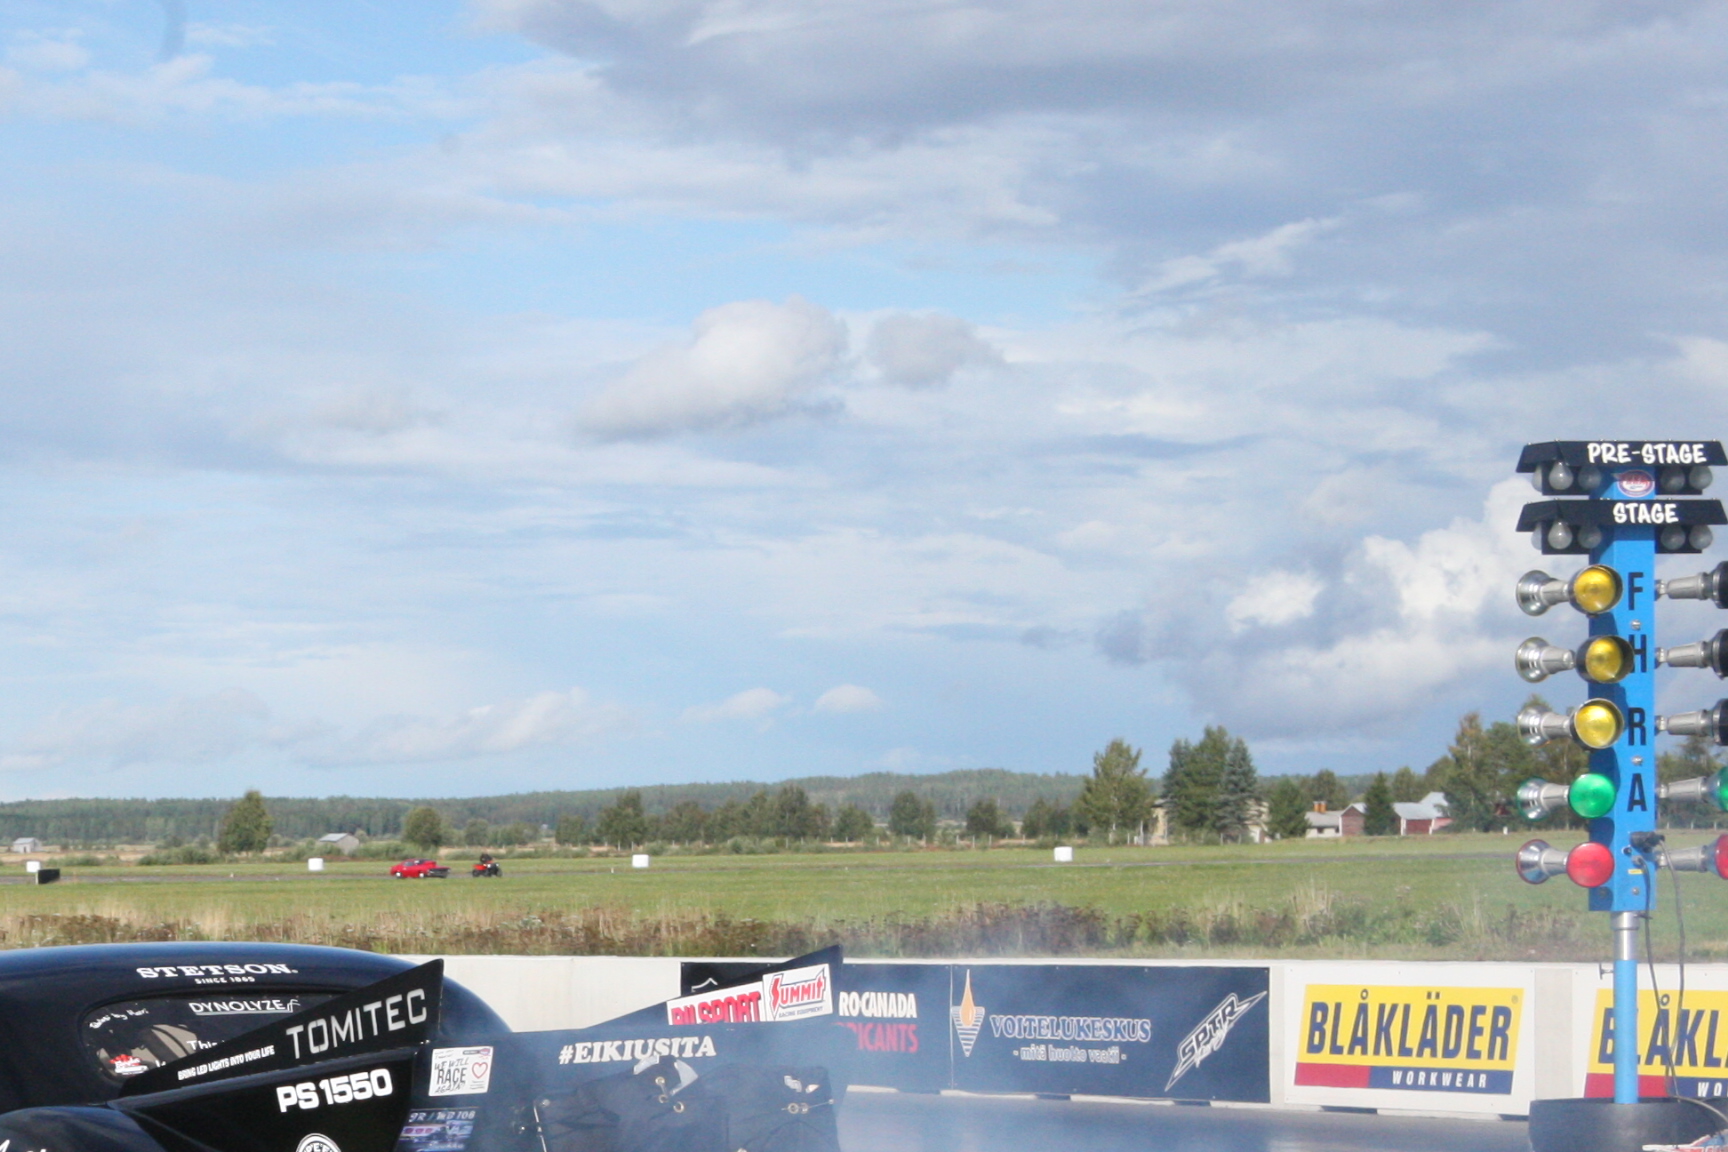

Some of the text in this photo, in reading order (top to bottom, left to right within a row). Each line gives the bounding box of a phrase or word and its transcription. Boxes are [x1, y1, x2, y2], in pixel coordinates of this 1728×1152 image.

[1587, 443, 1707, 464] PRE-STAGE
[1613, 503, 1679, 524] STAGE
[136, 963, 288, 979] STETSON
[195, 976, 228, 984] SINCE
[839, 991, 917, 1018] RO-CANADA
[286, 988, 427, 1060] TOMITEC
[989, 1015, 1151, 1042] VOITELUKESKUS
[1306, 988, 1512, 1061] BLÅKLÄDER
[196, 1064, 208, 1076] LED
[208, 1058, 229, 1072] LIGHTS
[230, 1054, 244, 1066] INTO
[244, 1049, 261, 1062] YOUR
[261, 1045, 275, 1058] LIFE
[559, 1035, 717, 1064] #EIKIUSITA
[436, 1067, 467, 1085] RACE
[1392, 1070, 1487, 1088] WORKWEAR
